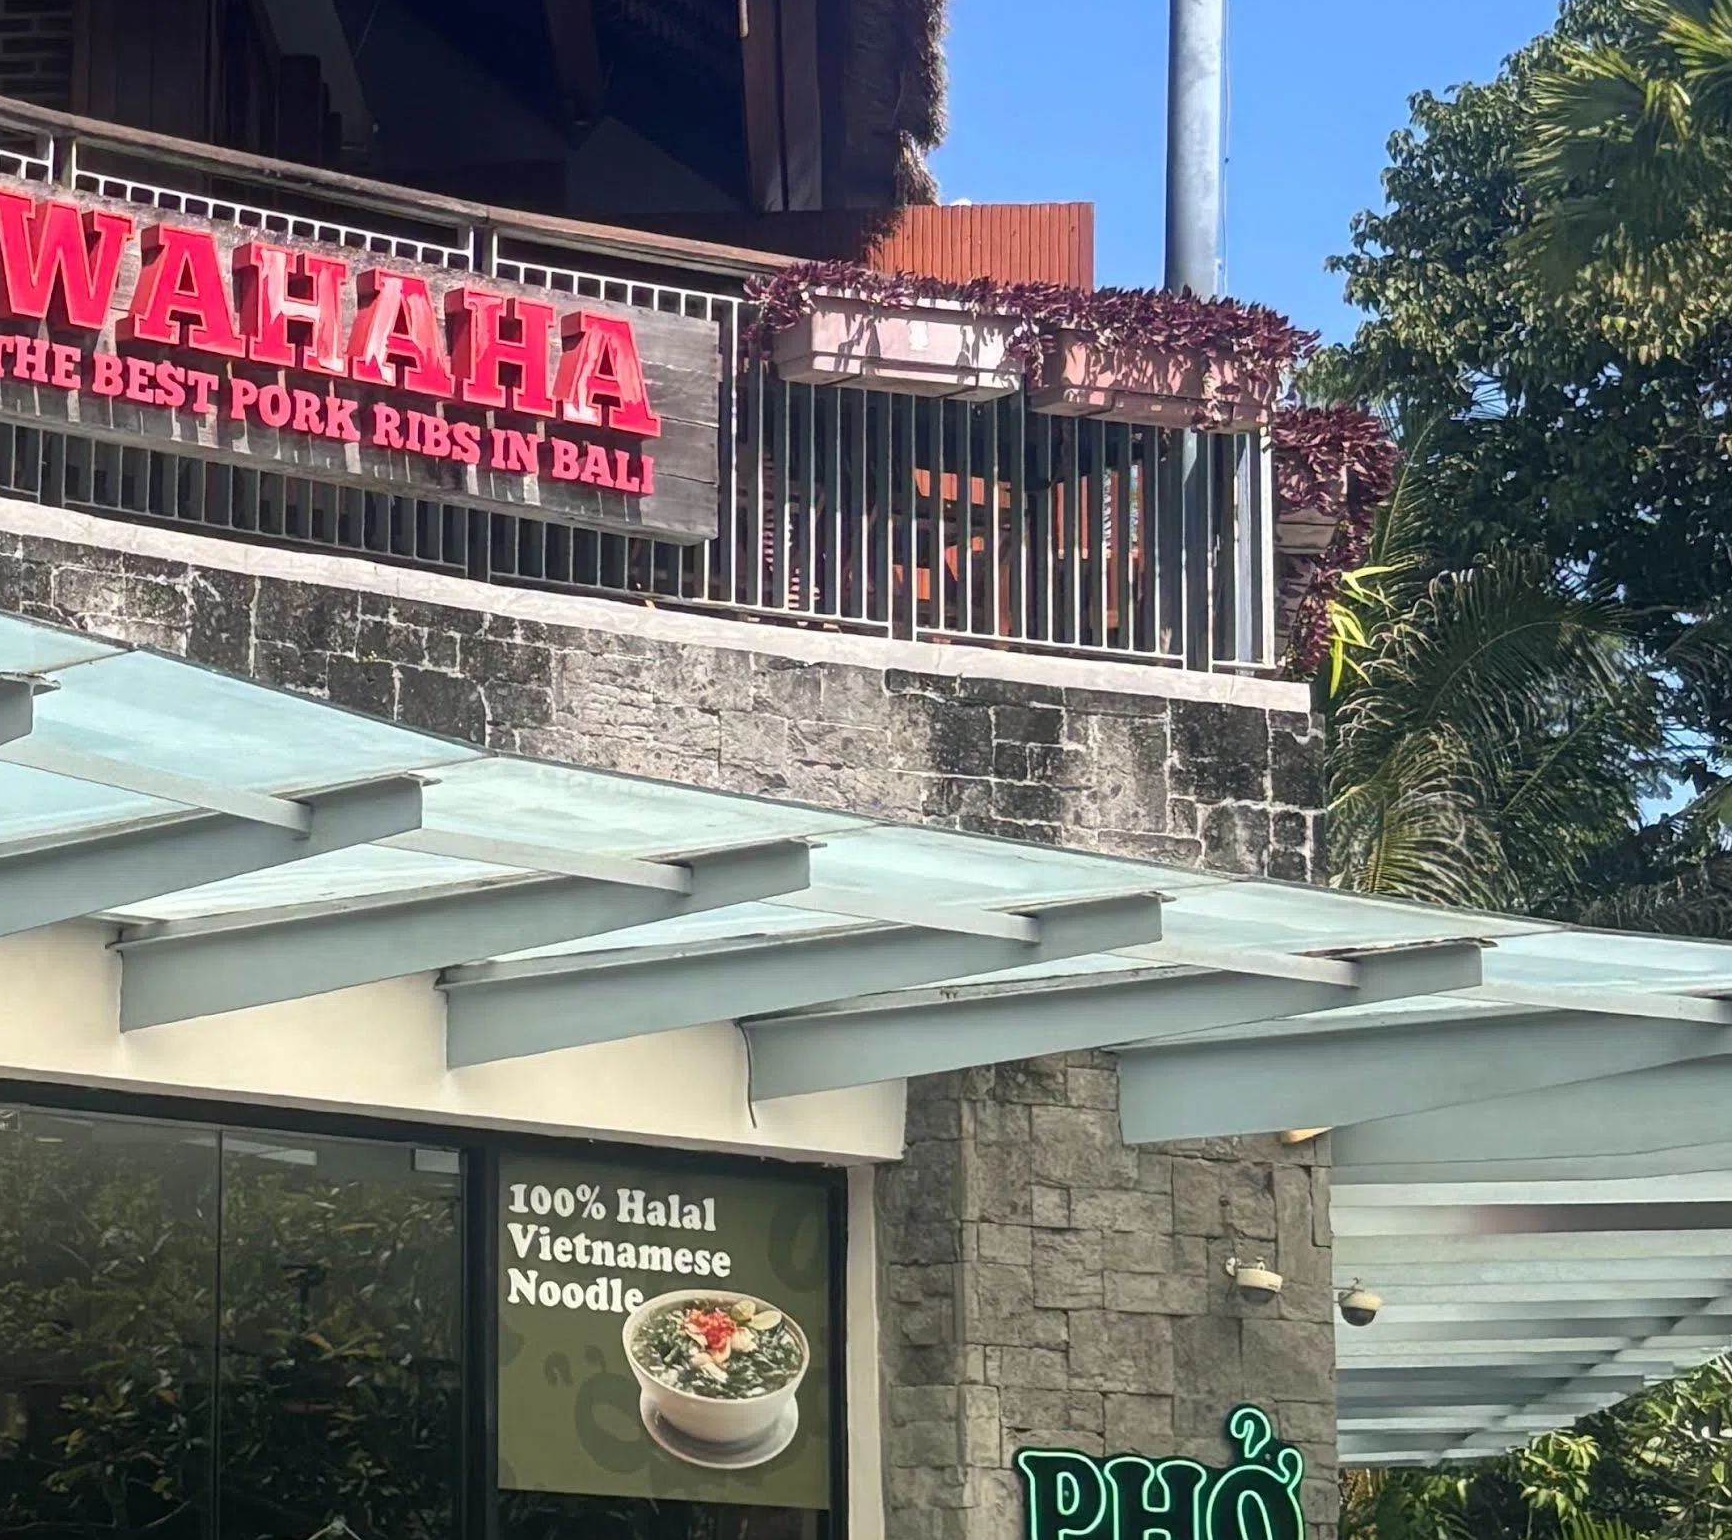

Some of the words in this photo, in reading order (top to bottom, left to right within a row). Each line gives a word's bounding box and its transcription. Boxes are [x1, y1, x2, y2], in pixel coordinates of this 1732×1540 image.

[92, 350, 220, 415] BEST
[230, 377, 362, 443] PORK
[372, 403, 481, 465] RIBS
[490, 429, 540, 475] IN
[551, 440, 655, 496] BALI
[508, 1183, 606, 1220] 100%
[616, 1188, 716, 1231] Halal
[507, 1223, 731, 1277] Vietnamese
[507, 1268, 645, 1314] Noodle
